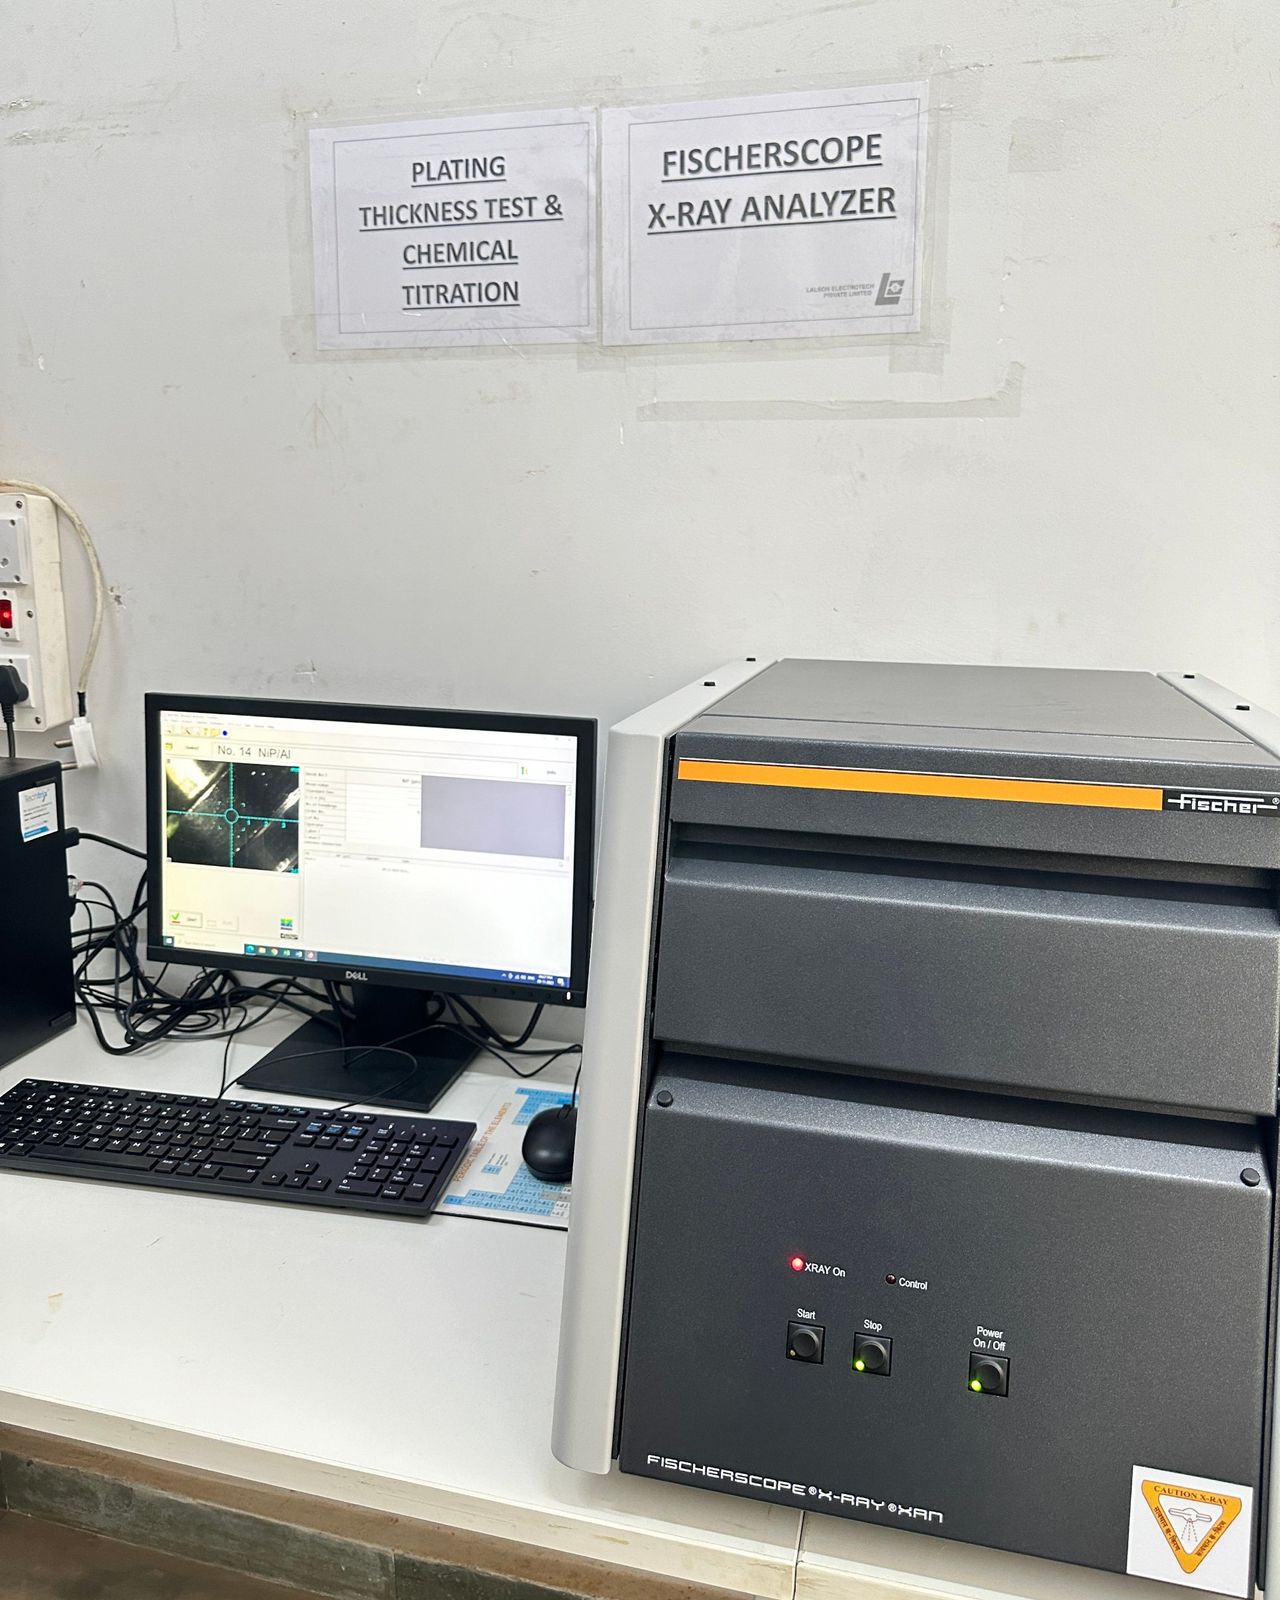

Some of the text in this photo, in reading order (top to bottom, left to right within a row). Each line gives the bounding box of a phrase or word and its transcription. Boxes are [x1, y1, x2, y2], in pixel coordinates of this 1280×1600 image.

[662, 133, 882, 177] FISCHERSCOPE
[412, 156, 506, 183] PLATING
[359, 194, 564, 227] THICKNESS TEST &
[647, 187, 897, 230] X-RAY ANALYZER
[402, 239, 519, 265] CHEMICAL
[402, 281, 519, 306] TITRATION
[218, 745, 236, 756] No.
[240, 747, 252, 756] 14
[345, 970, 369, 981] DELL
[804, 1262, 846, 1278] XRAY On
[899, 1277, 928, 1291] Control
[797, 1308, 816, 1320] Start
[863, 1319, 883, 1332] Stop
[976, 1325, 1004, 1339] Power
[973, 1337, 986, 1348] On
[993, 1340, 1006, 1352] Off
[1153, 1485, 1229, 1506] CAUTION X-RAY
[898, 1504, 944, 1524] XAN
